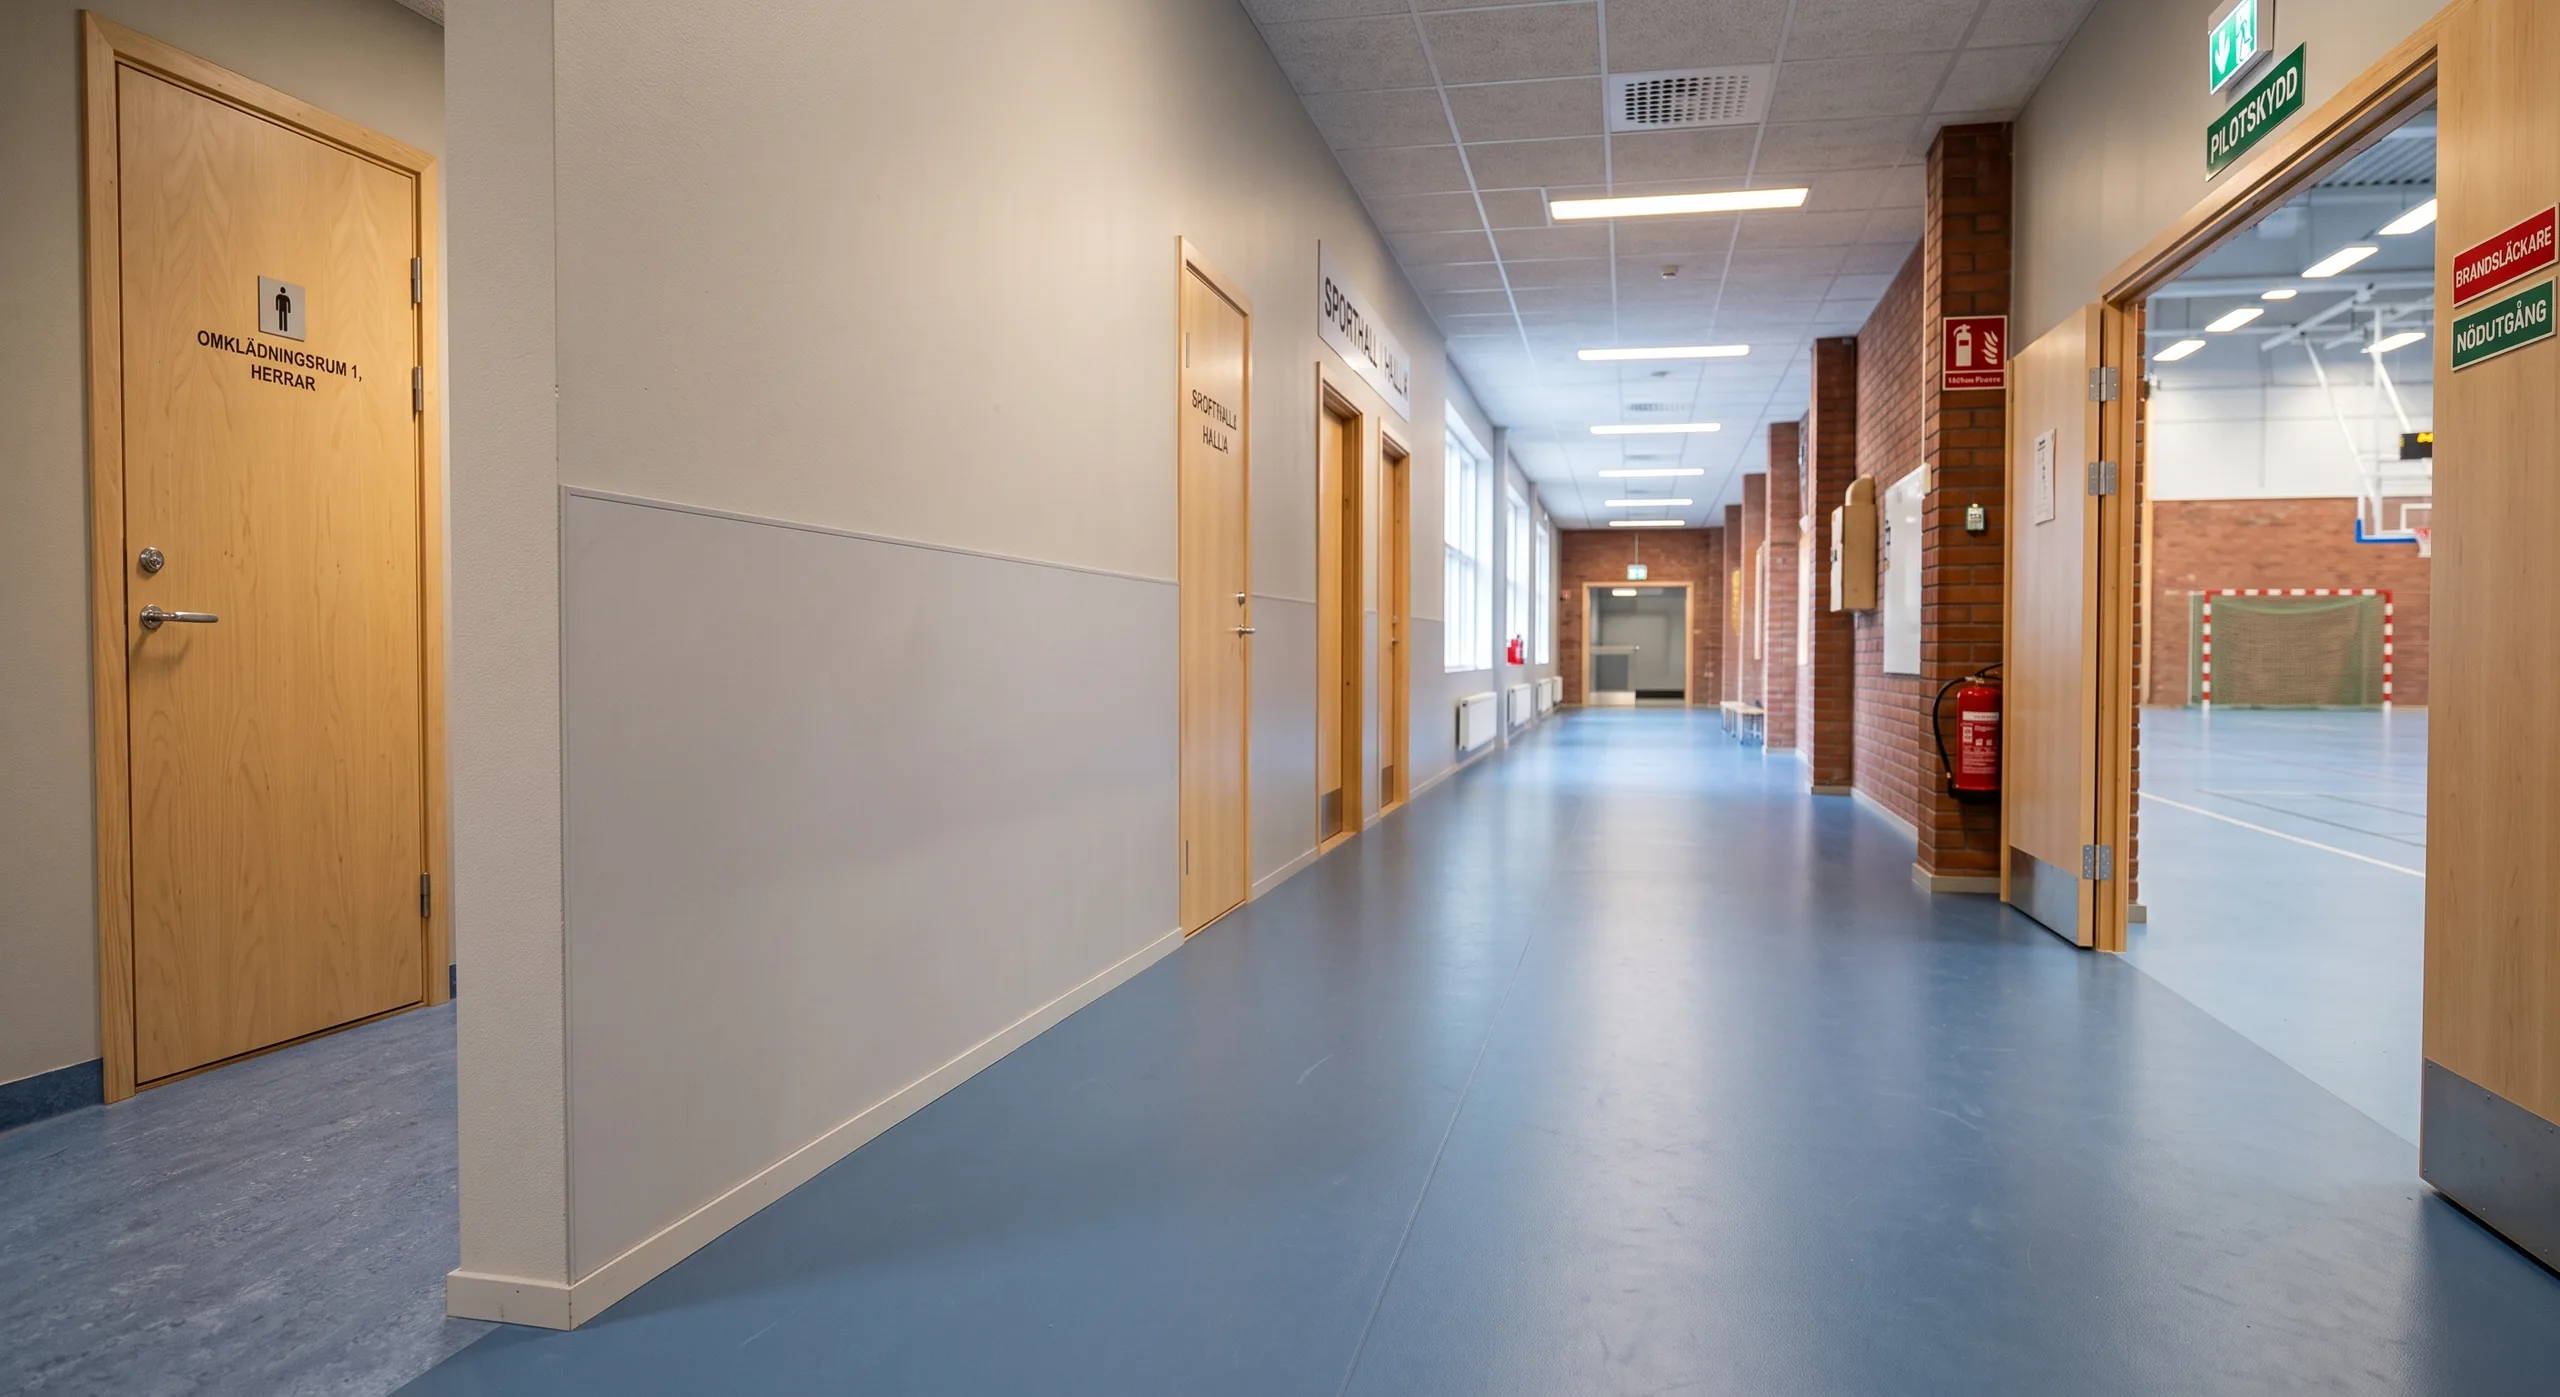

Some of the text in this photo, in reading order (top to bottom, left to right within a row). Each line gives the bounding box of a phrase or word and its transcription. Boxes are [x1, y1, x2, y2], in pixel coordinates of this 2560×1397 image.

[2210, 65, 2298, 165] PILOTSKYDD
[2455, 225, 2553, 289] BRANDSLÄCKARE
[2456, 299, 2547, 354] NÖDUTGÅNG
[196, 329, 363, 383] OMKLÄDNINGSRUM 1,
[250, 364, 316, 391] HERRAR
